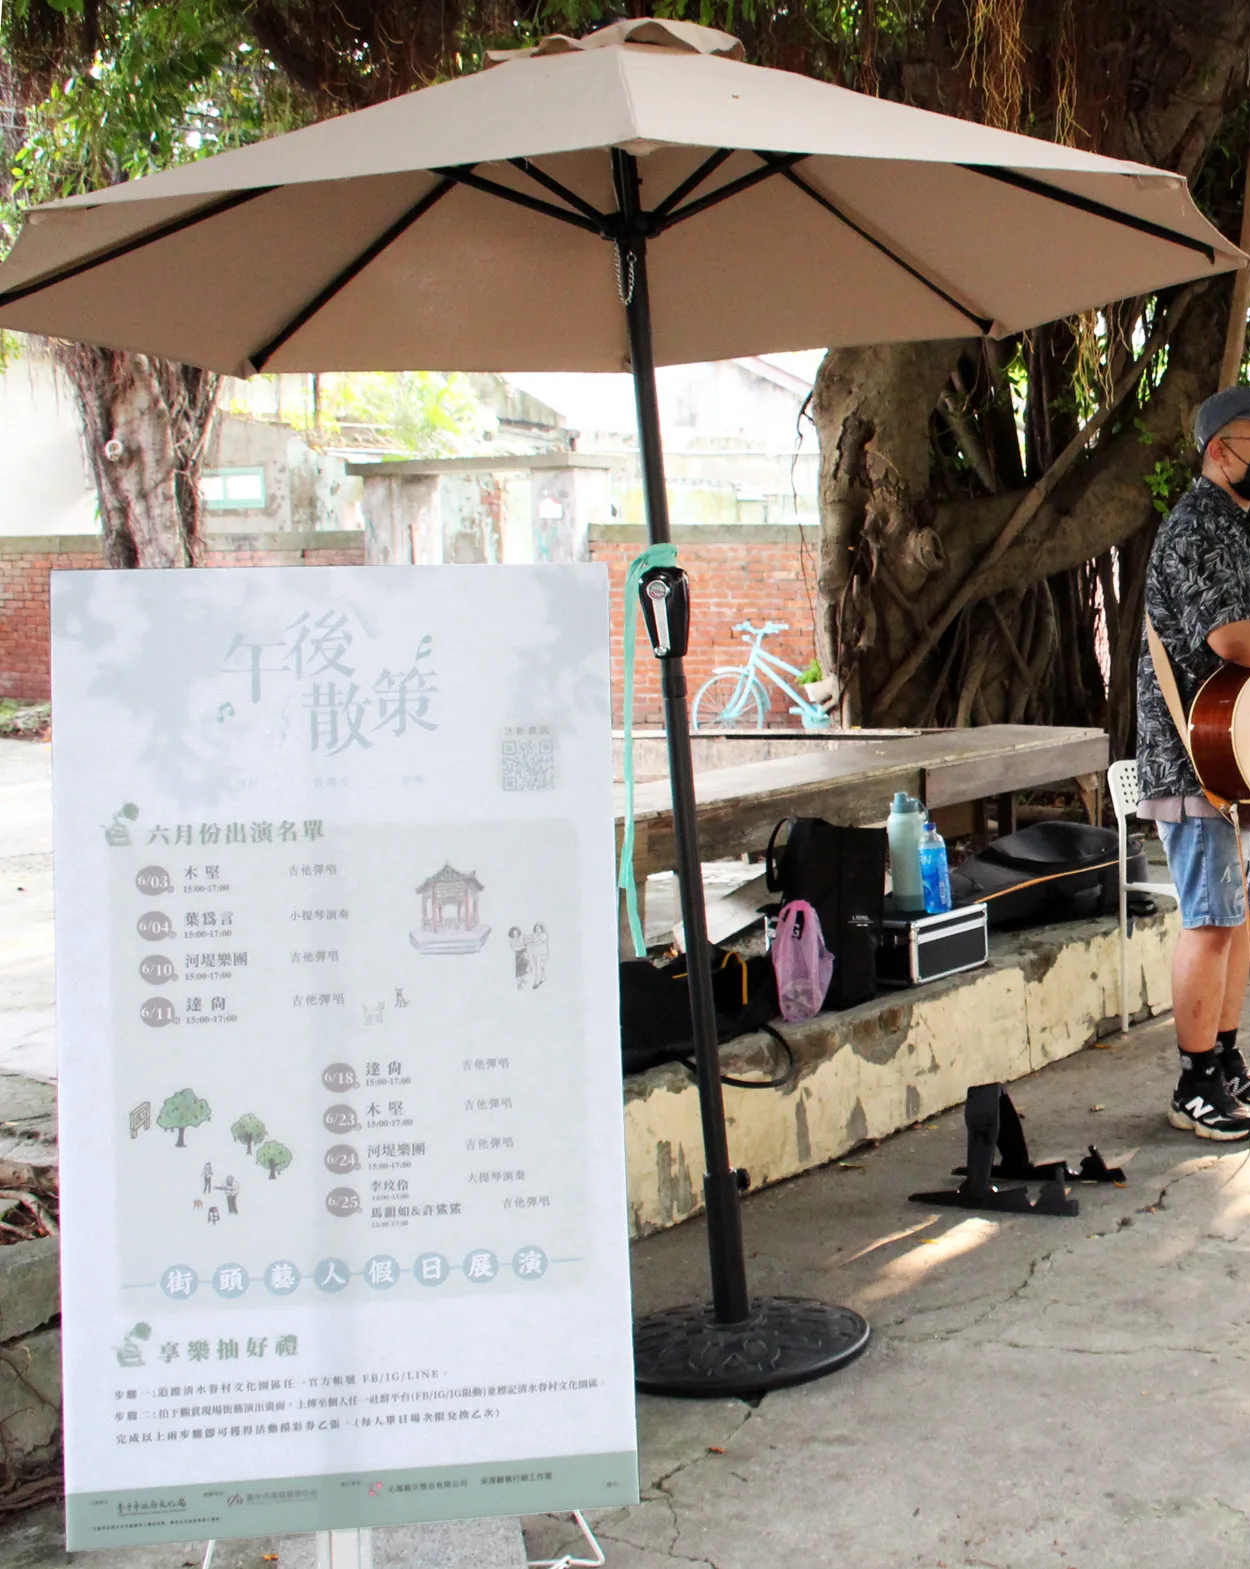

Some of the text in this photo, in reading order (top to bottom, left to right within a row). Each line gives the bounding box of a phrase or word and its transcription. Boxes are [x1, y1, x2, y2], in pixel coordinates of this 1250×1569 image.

[220, 608, 356, 704] 午後
[301, 666, 441, 757] 散策
[147, 819, 325, 847] 六月份出演名單
[290, 909, 350, 922] 小提琴演奏
[165, 1250, 544, 1295] 街頭藝人假日展演
[157, 1333, 299, 1364] 享樂抽好禮
